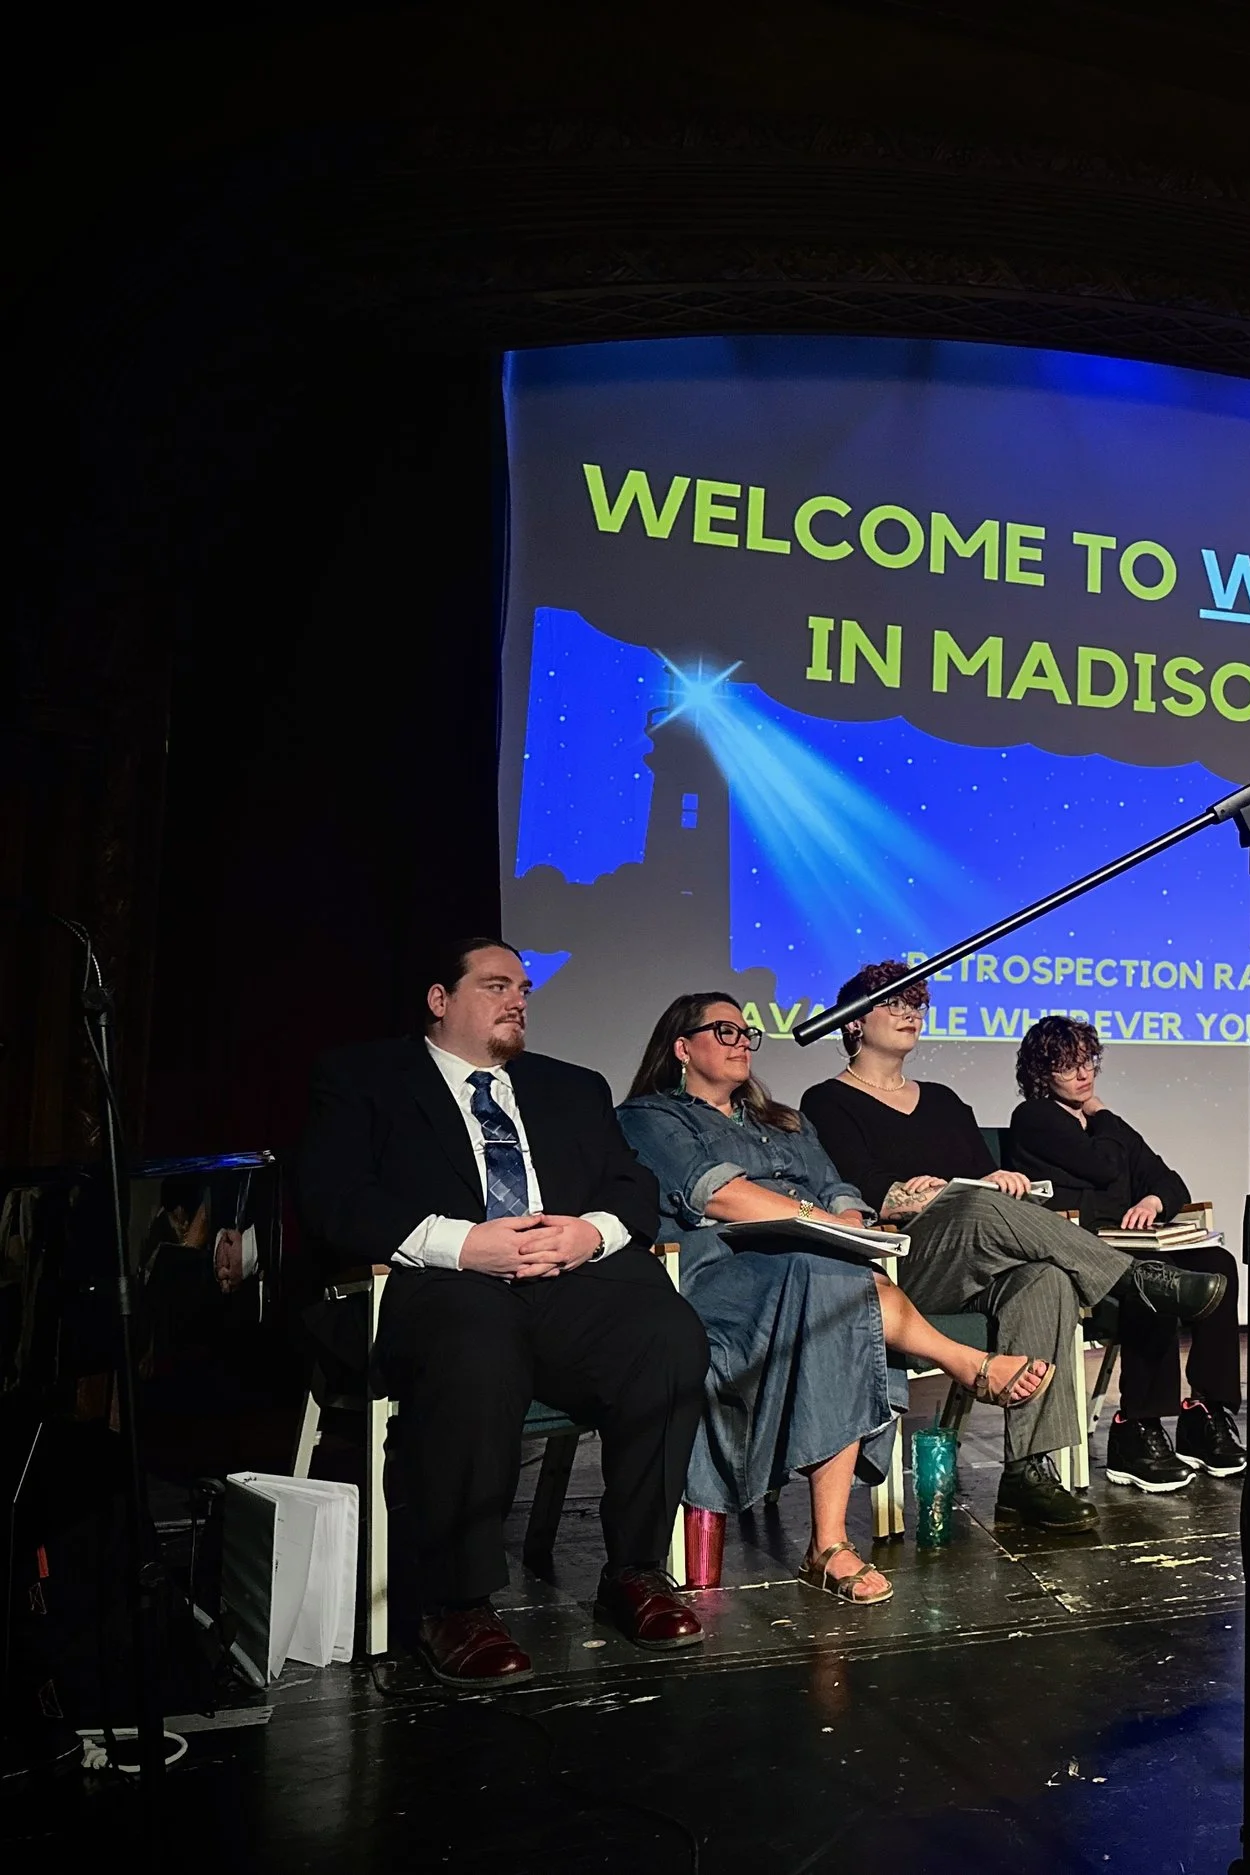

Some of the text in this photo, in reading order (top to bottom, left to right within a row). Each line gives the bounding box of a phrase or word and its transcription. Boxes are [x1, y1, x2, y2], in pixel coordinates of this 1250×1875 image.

[582, 463, 1045, 586] WELCOME
[1073, 532, 1177, 601] TO
[806, 615, 902, 689] IN
